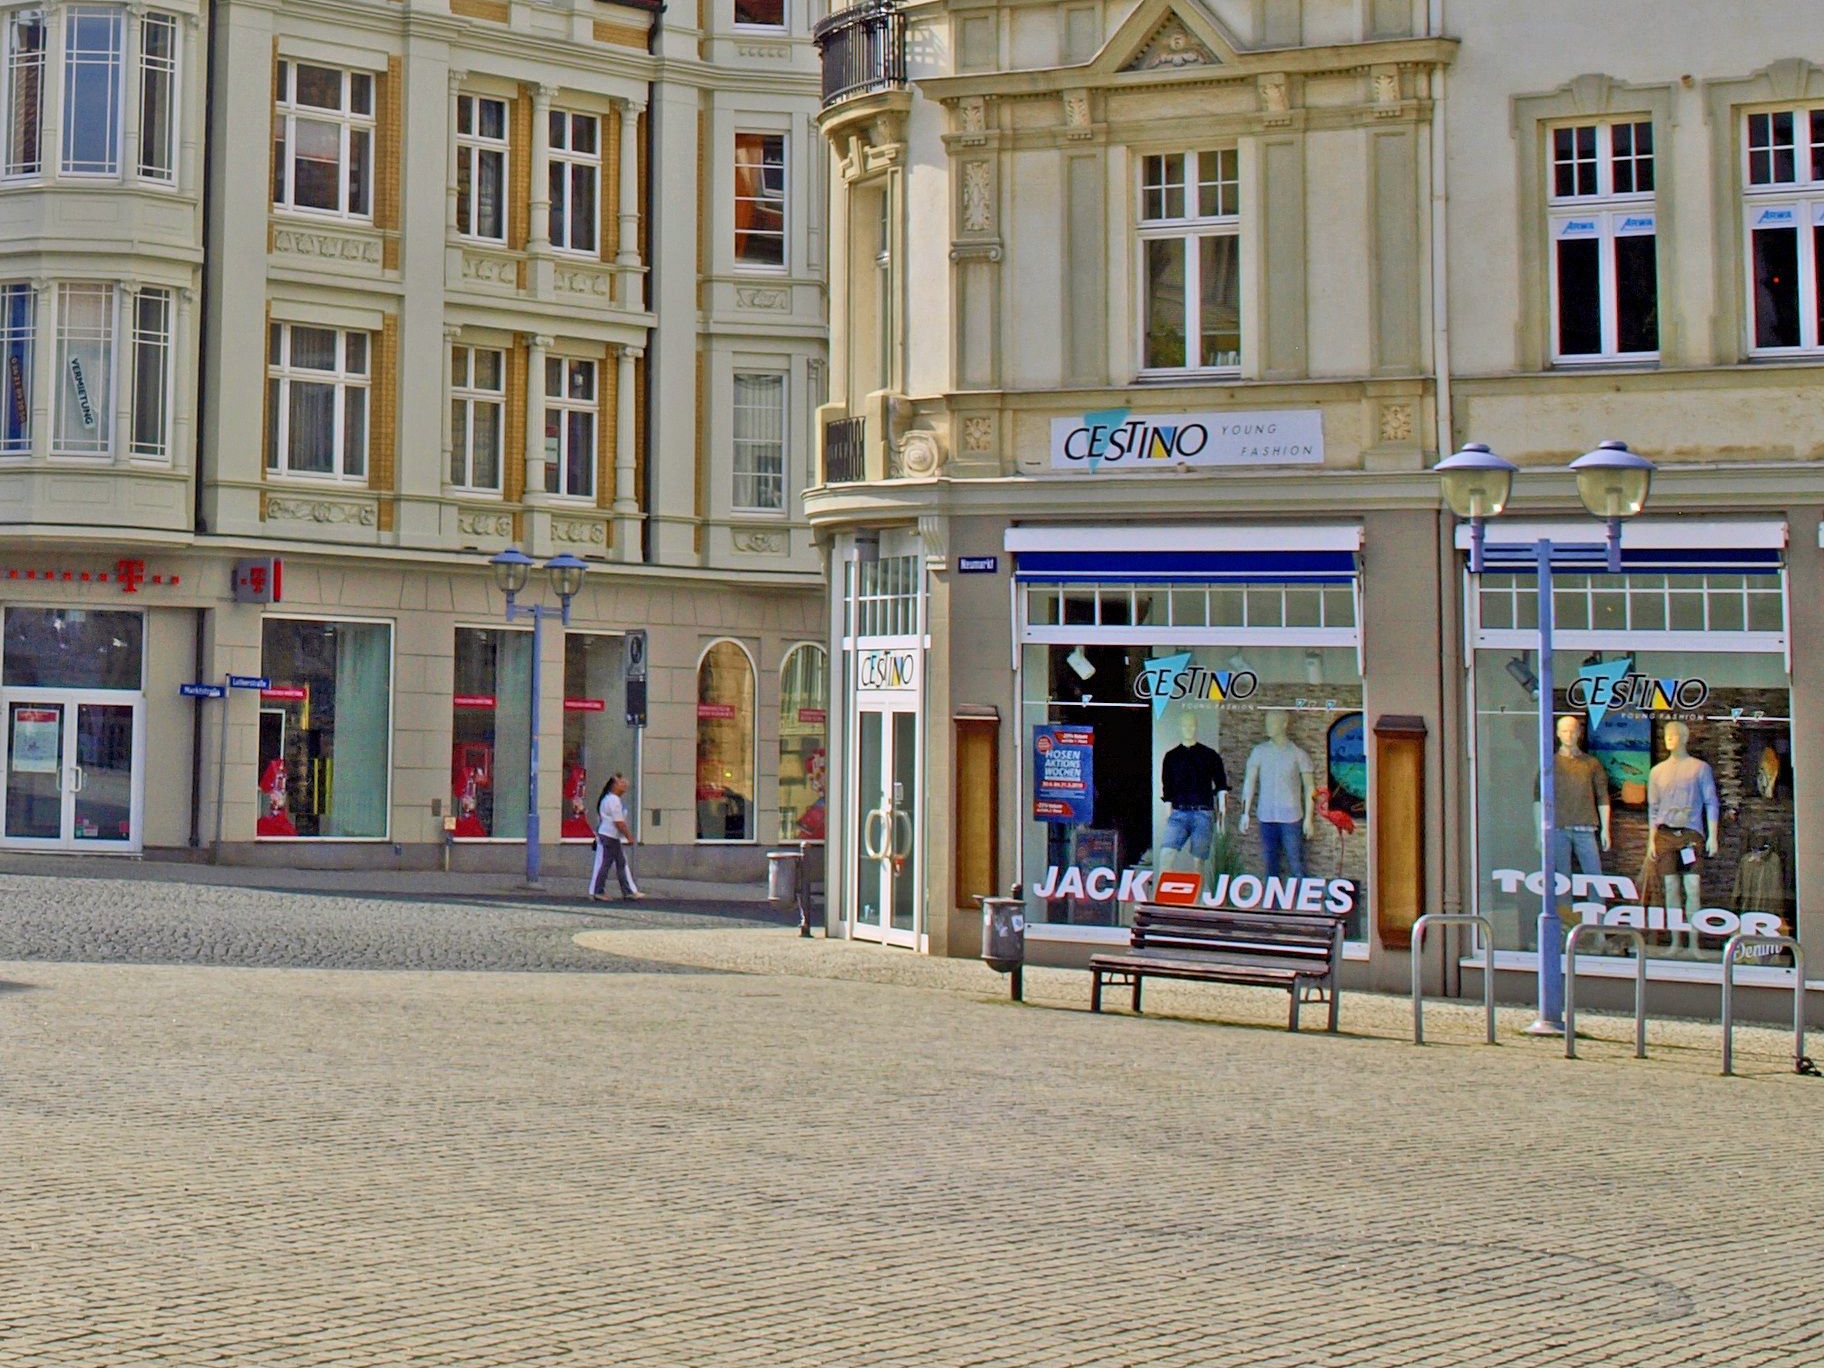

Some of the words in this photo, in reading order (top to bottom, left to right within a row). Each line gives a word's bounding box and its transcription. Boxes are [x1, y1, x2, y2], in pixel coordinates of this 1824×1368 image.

[71, 358, 94, 425] VERMIETUNG
[1064, 421, 1209, 462] CESTINO
[1221, 424, 1278, 436] YOUNG
[1240, 446, 1313, 457] FASHION
[861, 650, 914, 688] CESTINO
[1133, 665, 1259, 701] CESTINO
[1566, 672, 1709, 711] CESTINO
[1045, 750, 1081, 759] HOSEN
[1033, 865, 1154, 903] JACK
[1202, 873, 1355, 915] JONES
[1572, 901, 1783, 937] TAILOR
